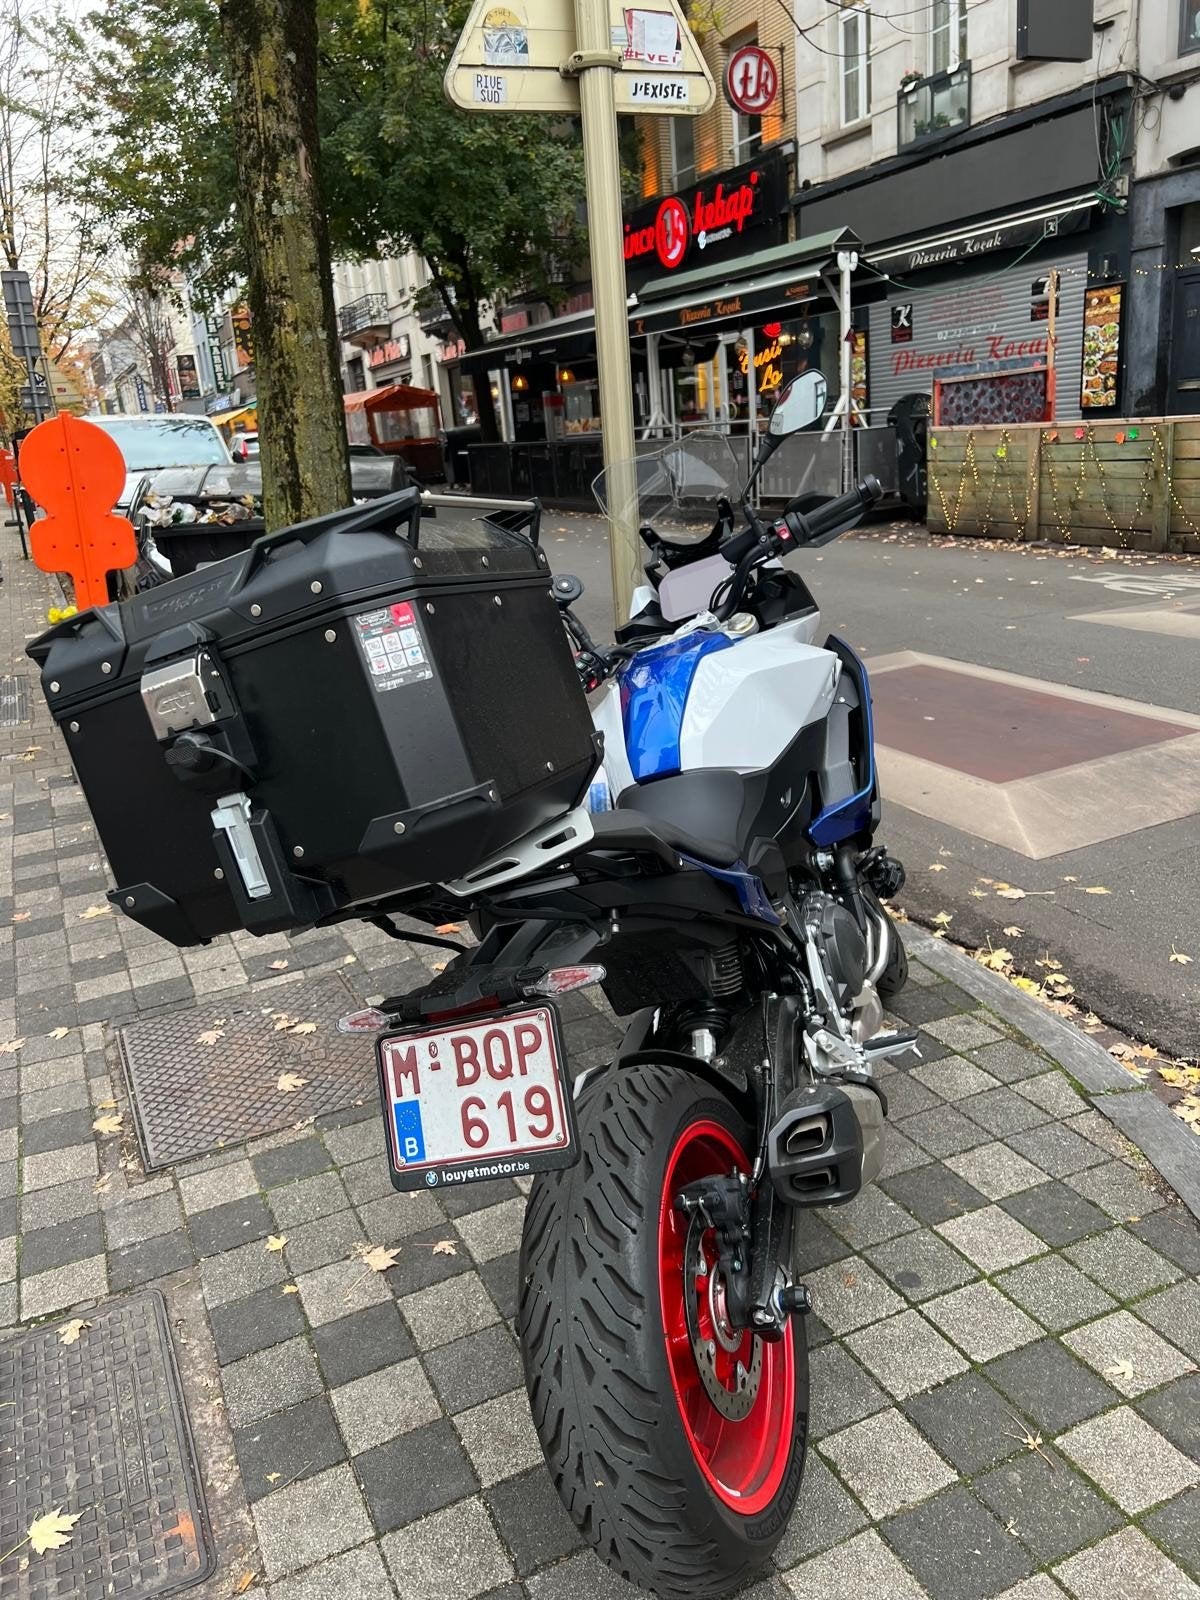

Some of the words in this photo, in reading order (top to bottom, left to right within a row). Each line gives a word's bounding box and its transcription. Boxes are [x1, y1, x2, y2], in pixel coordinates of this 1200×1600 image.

[476, 74, 503, 91] RIVE
[632, 82, 687, 100] J'EXISTE.
[480, 89, 500, 104] SUD
[909, 244, 958, 269] Pizzeria
[960, 231, 1002, 256] Koçak
[892, 304, 912, 329] K
[890, 343, 976, 377] Pizzeria
[460, 1085, 555, 1149] 619
[404, 1137, 419, 1157] B
[441, 1161, 530, 1183] louyetmotor.be
